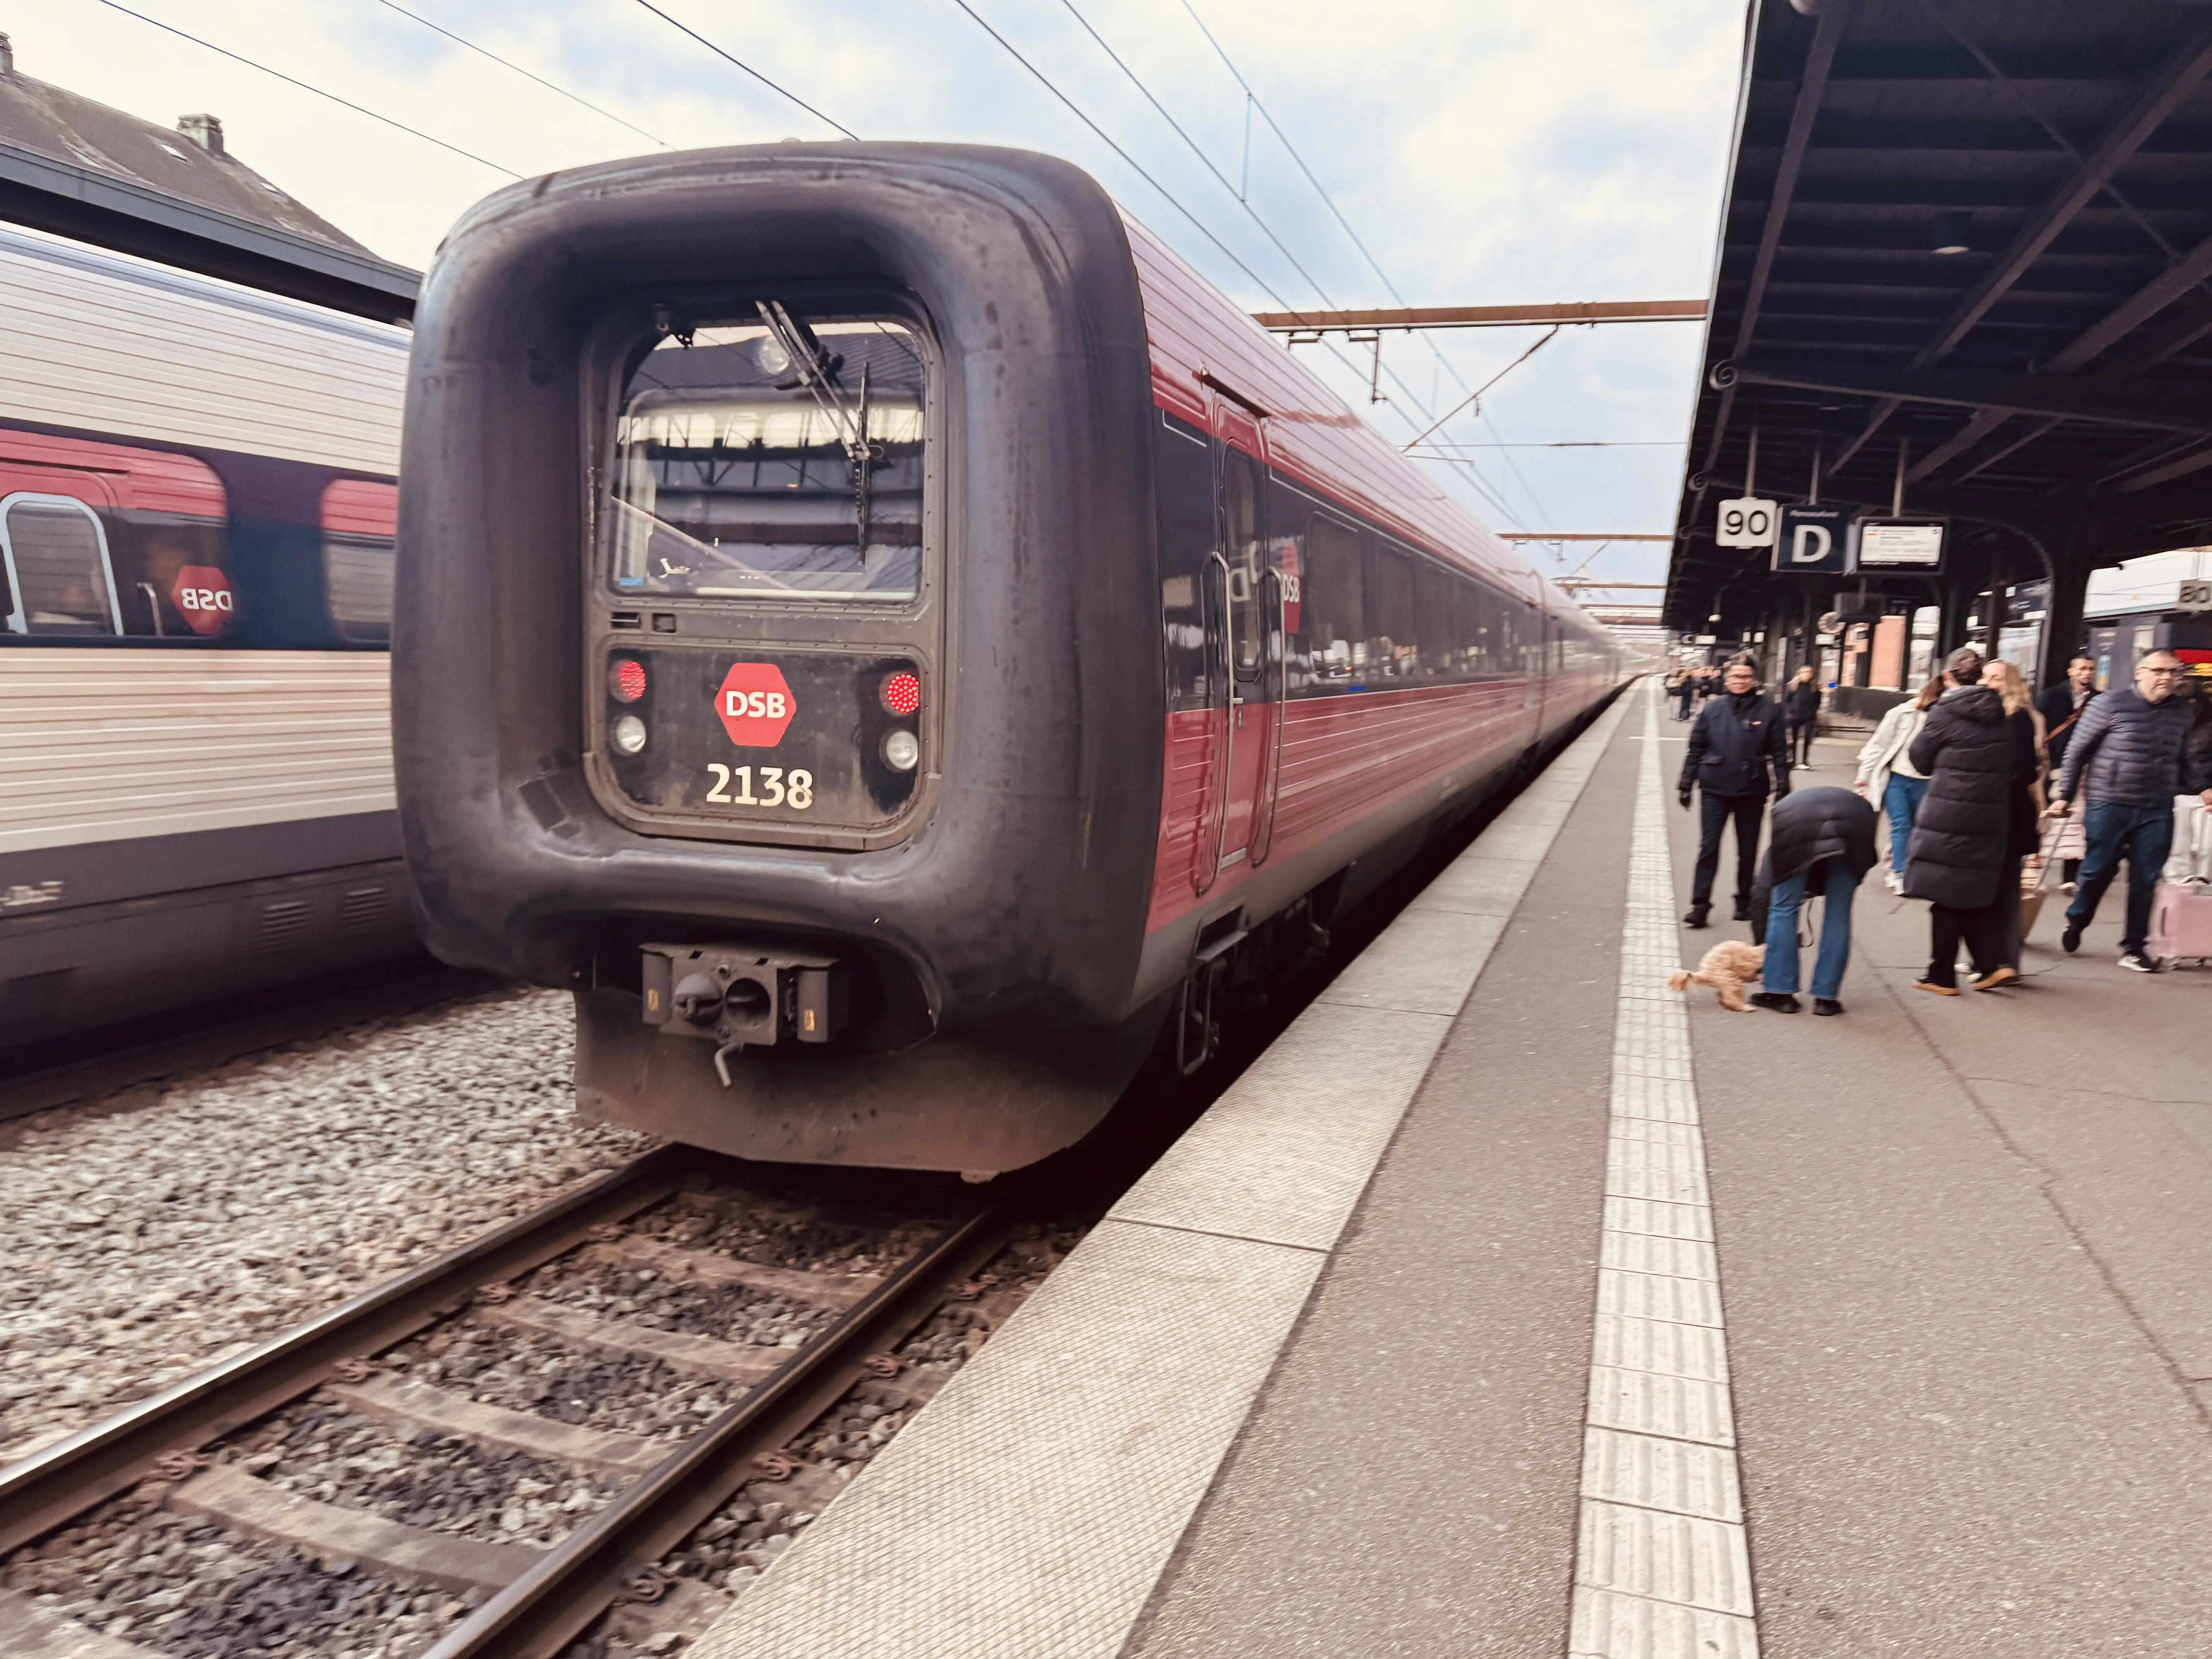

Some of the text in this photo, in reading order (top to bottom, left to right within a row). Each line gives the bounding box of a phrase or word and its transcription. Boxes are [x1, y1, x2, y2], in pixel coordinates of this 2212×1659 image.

[1726, 510, 1768, 535] 90
[1791, 524, 1832, 563] D
[1282, 574, 1300, 603] DSB
[726, 690, 786, 718] DSB
[706, 763, 813, 809] 2138
